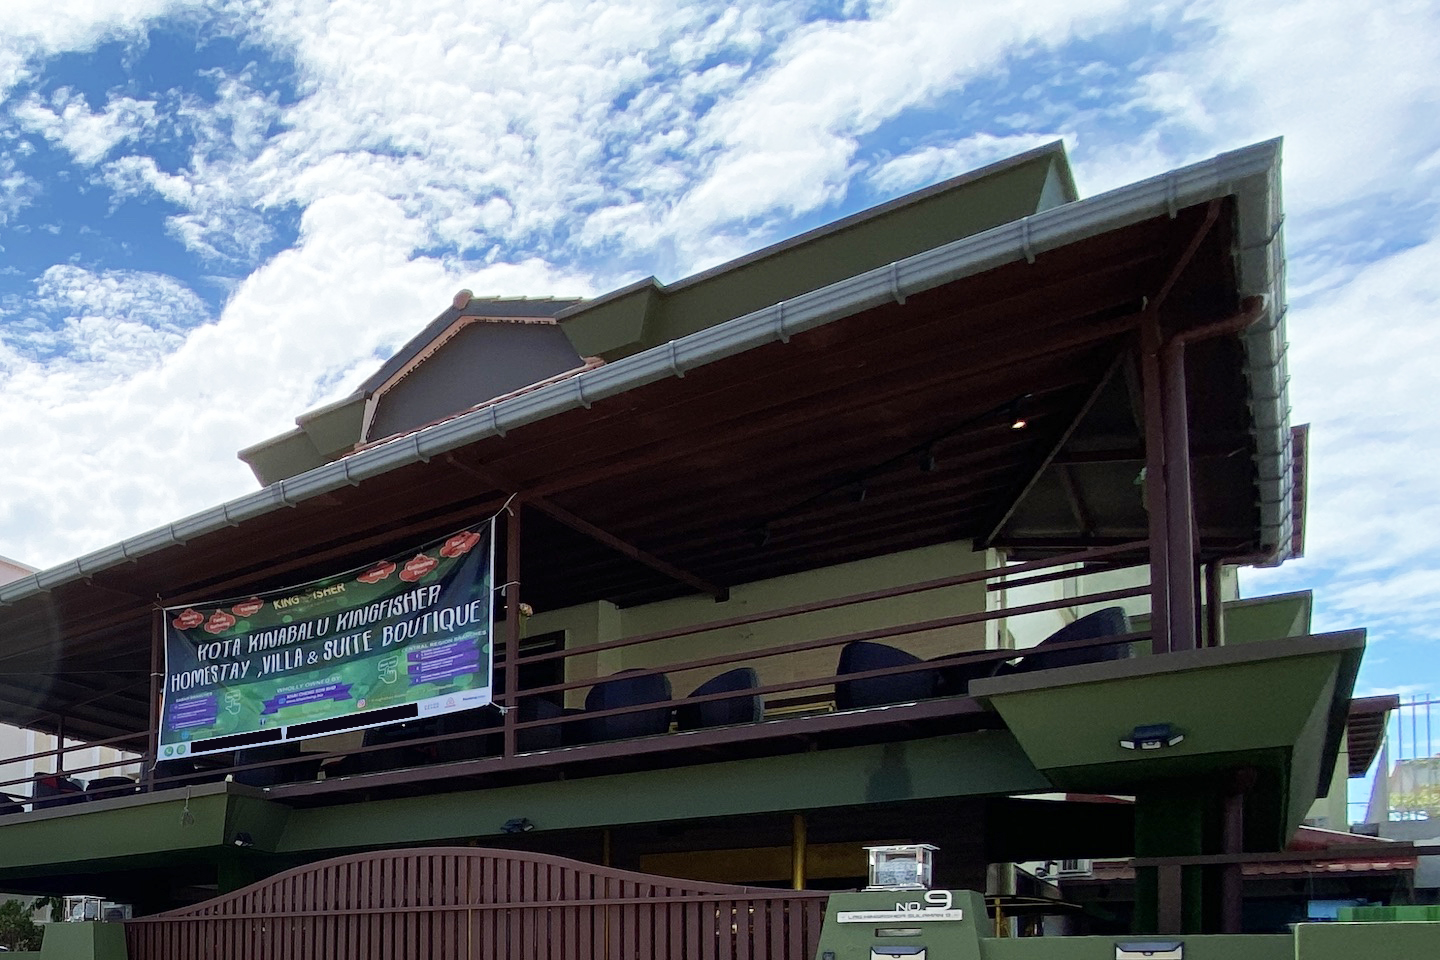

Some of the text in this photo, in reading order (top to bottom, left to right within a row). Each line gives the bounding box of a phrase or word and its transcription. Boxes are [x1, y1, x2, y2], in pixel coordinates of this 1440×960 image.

[171, 660, 250, 692] HOMESTAY
[307, 650, 318, 665] &
[323, 630, 373, 660] SUITE
[382, 600, 481, 647] BOUTIQUE
[197, 584, 442, 662] KOTA KINABALU KINGFISHER
